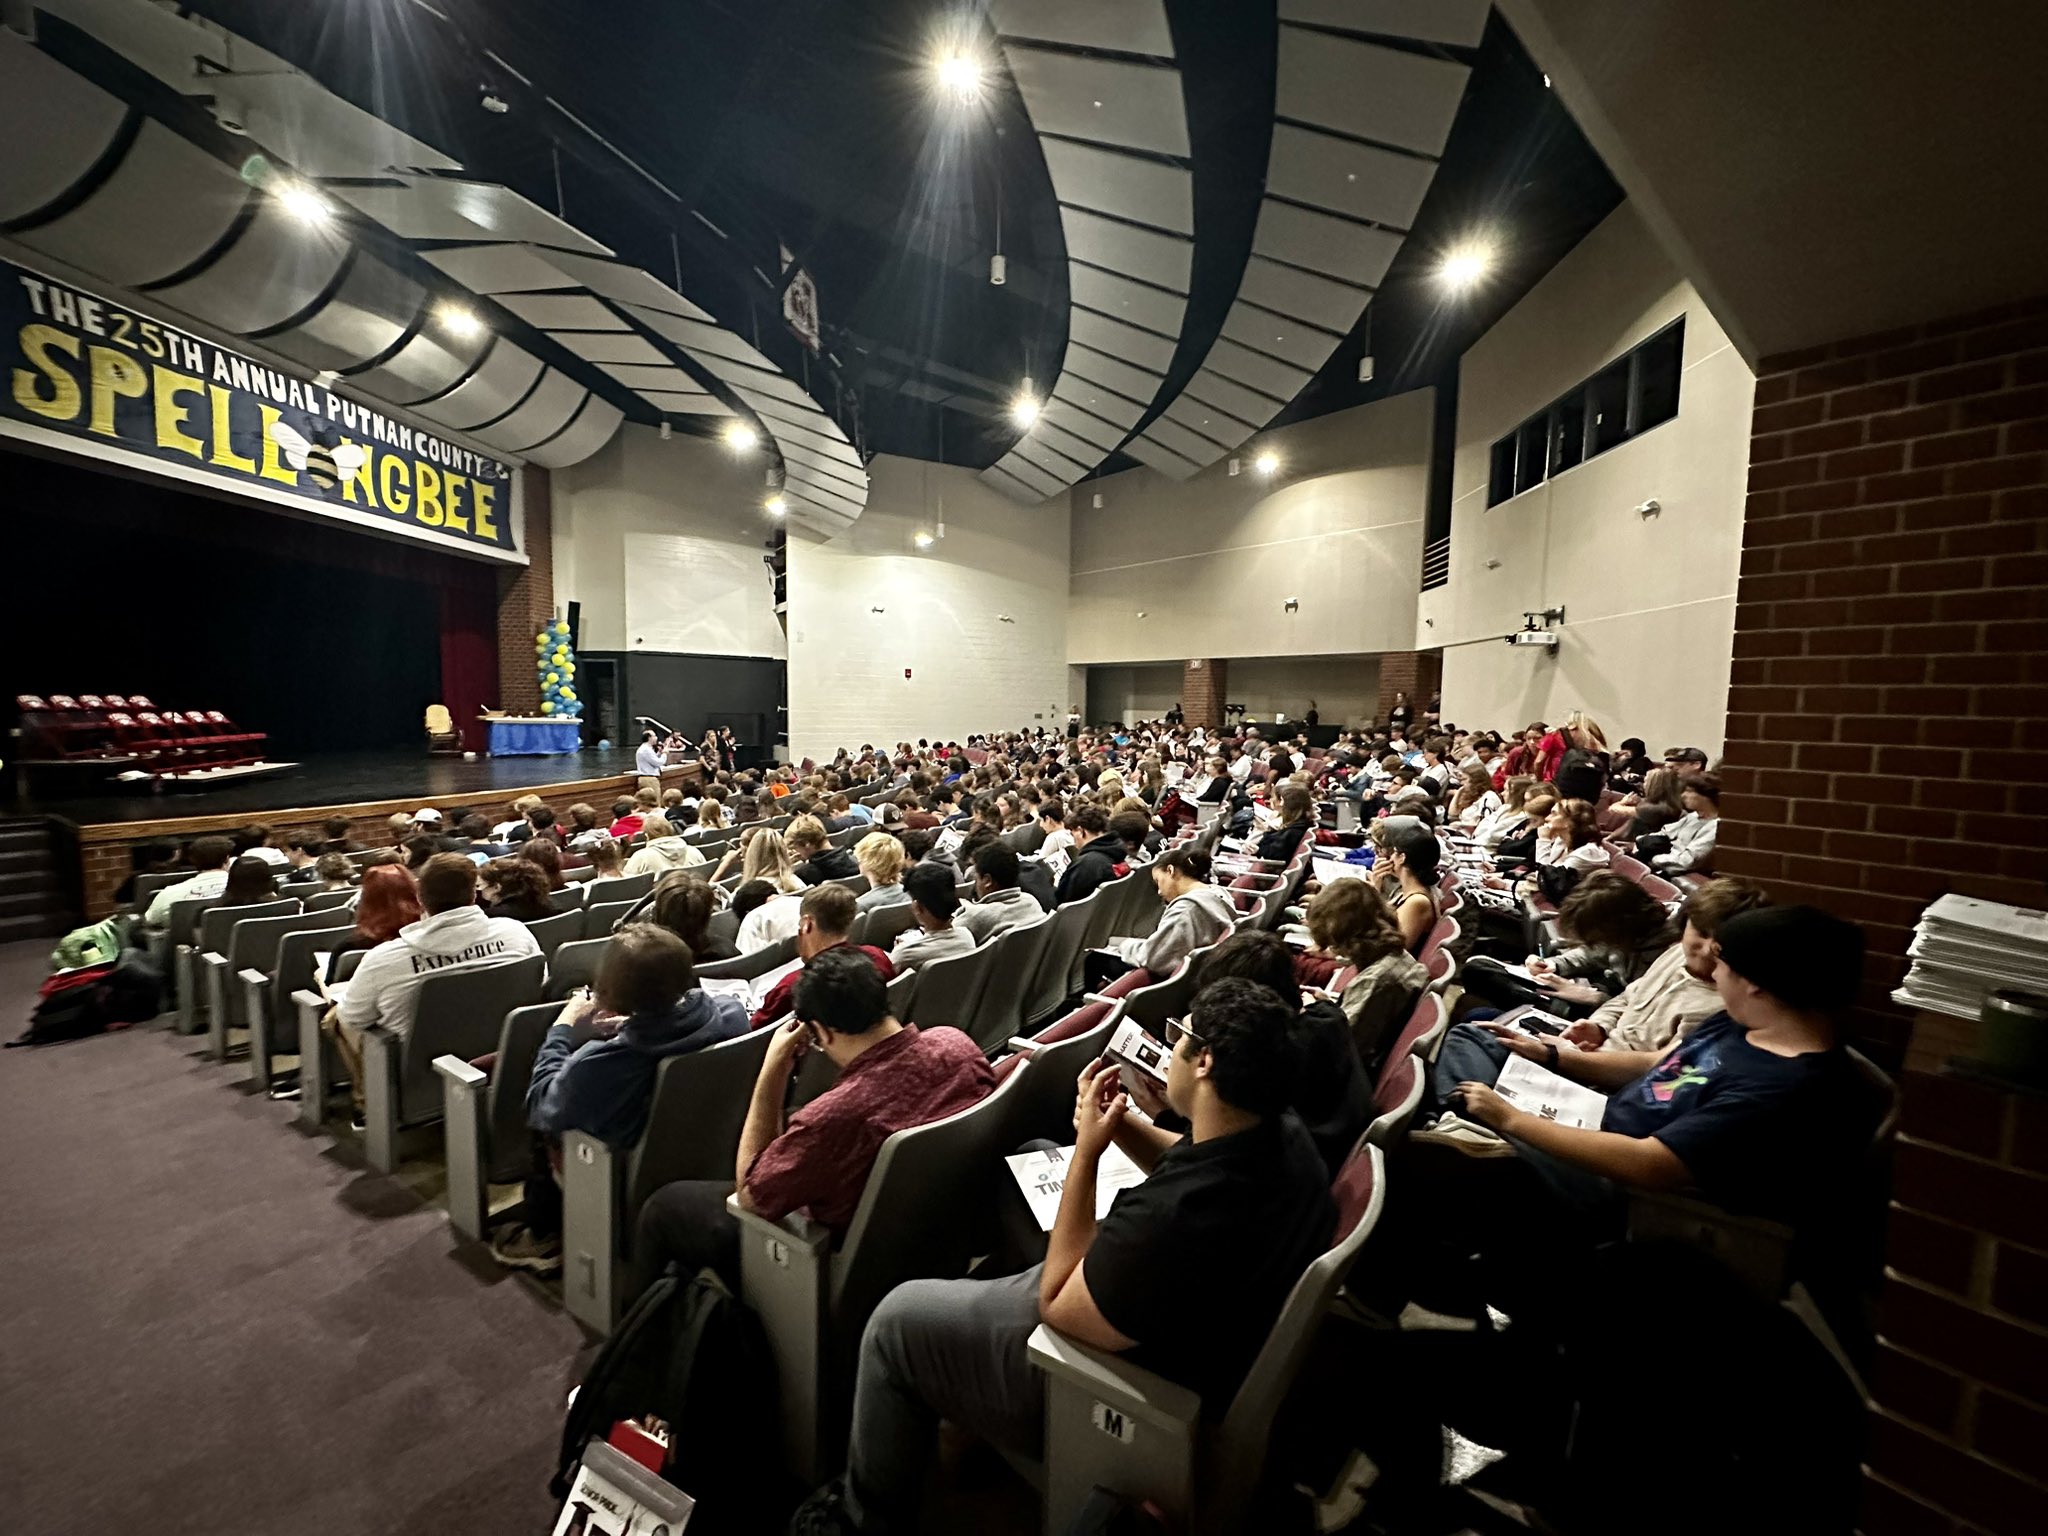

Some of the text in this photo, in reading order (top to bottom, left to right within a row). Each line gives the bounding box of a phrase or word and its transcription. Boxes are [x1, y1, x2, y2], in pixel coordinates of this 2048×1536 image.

[19, 275, 484, 477] THE 25TH ANNUAL PUTNAM COUNTY
[1104, 1408, 1123, 1438] M
